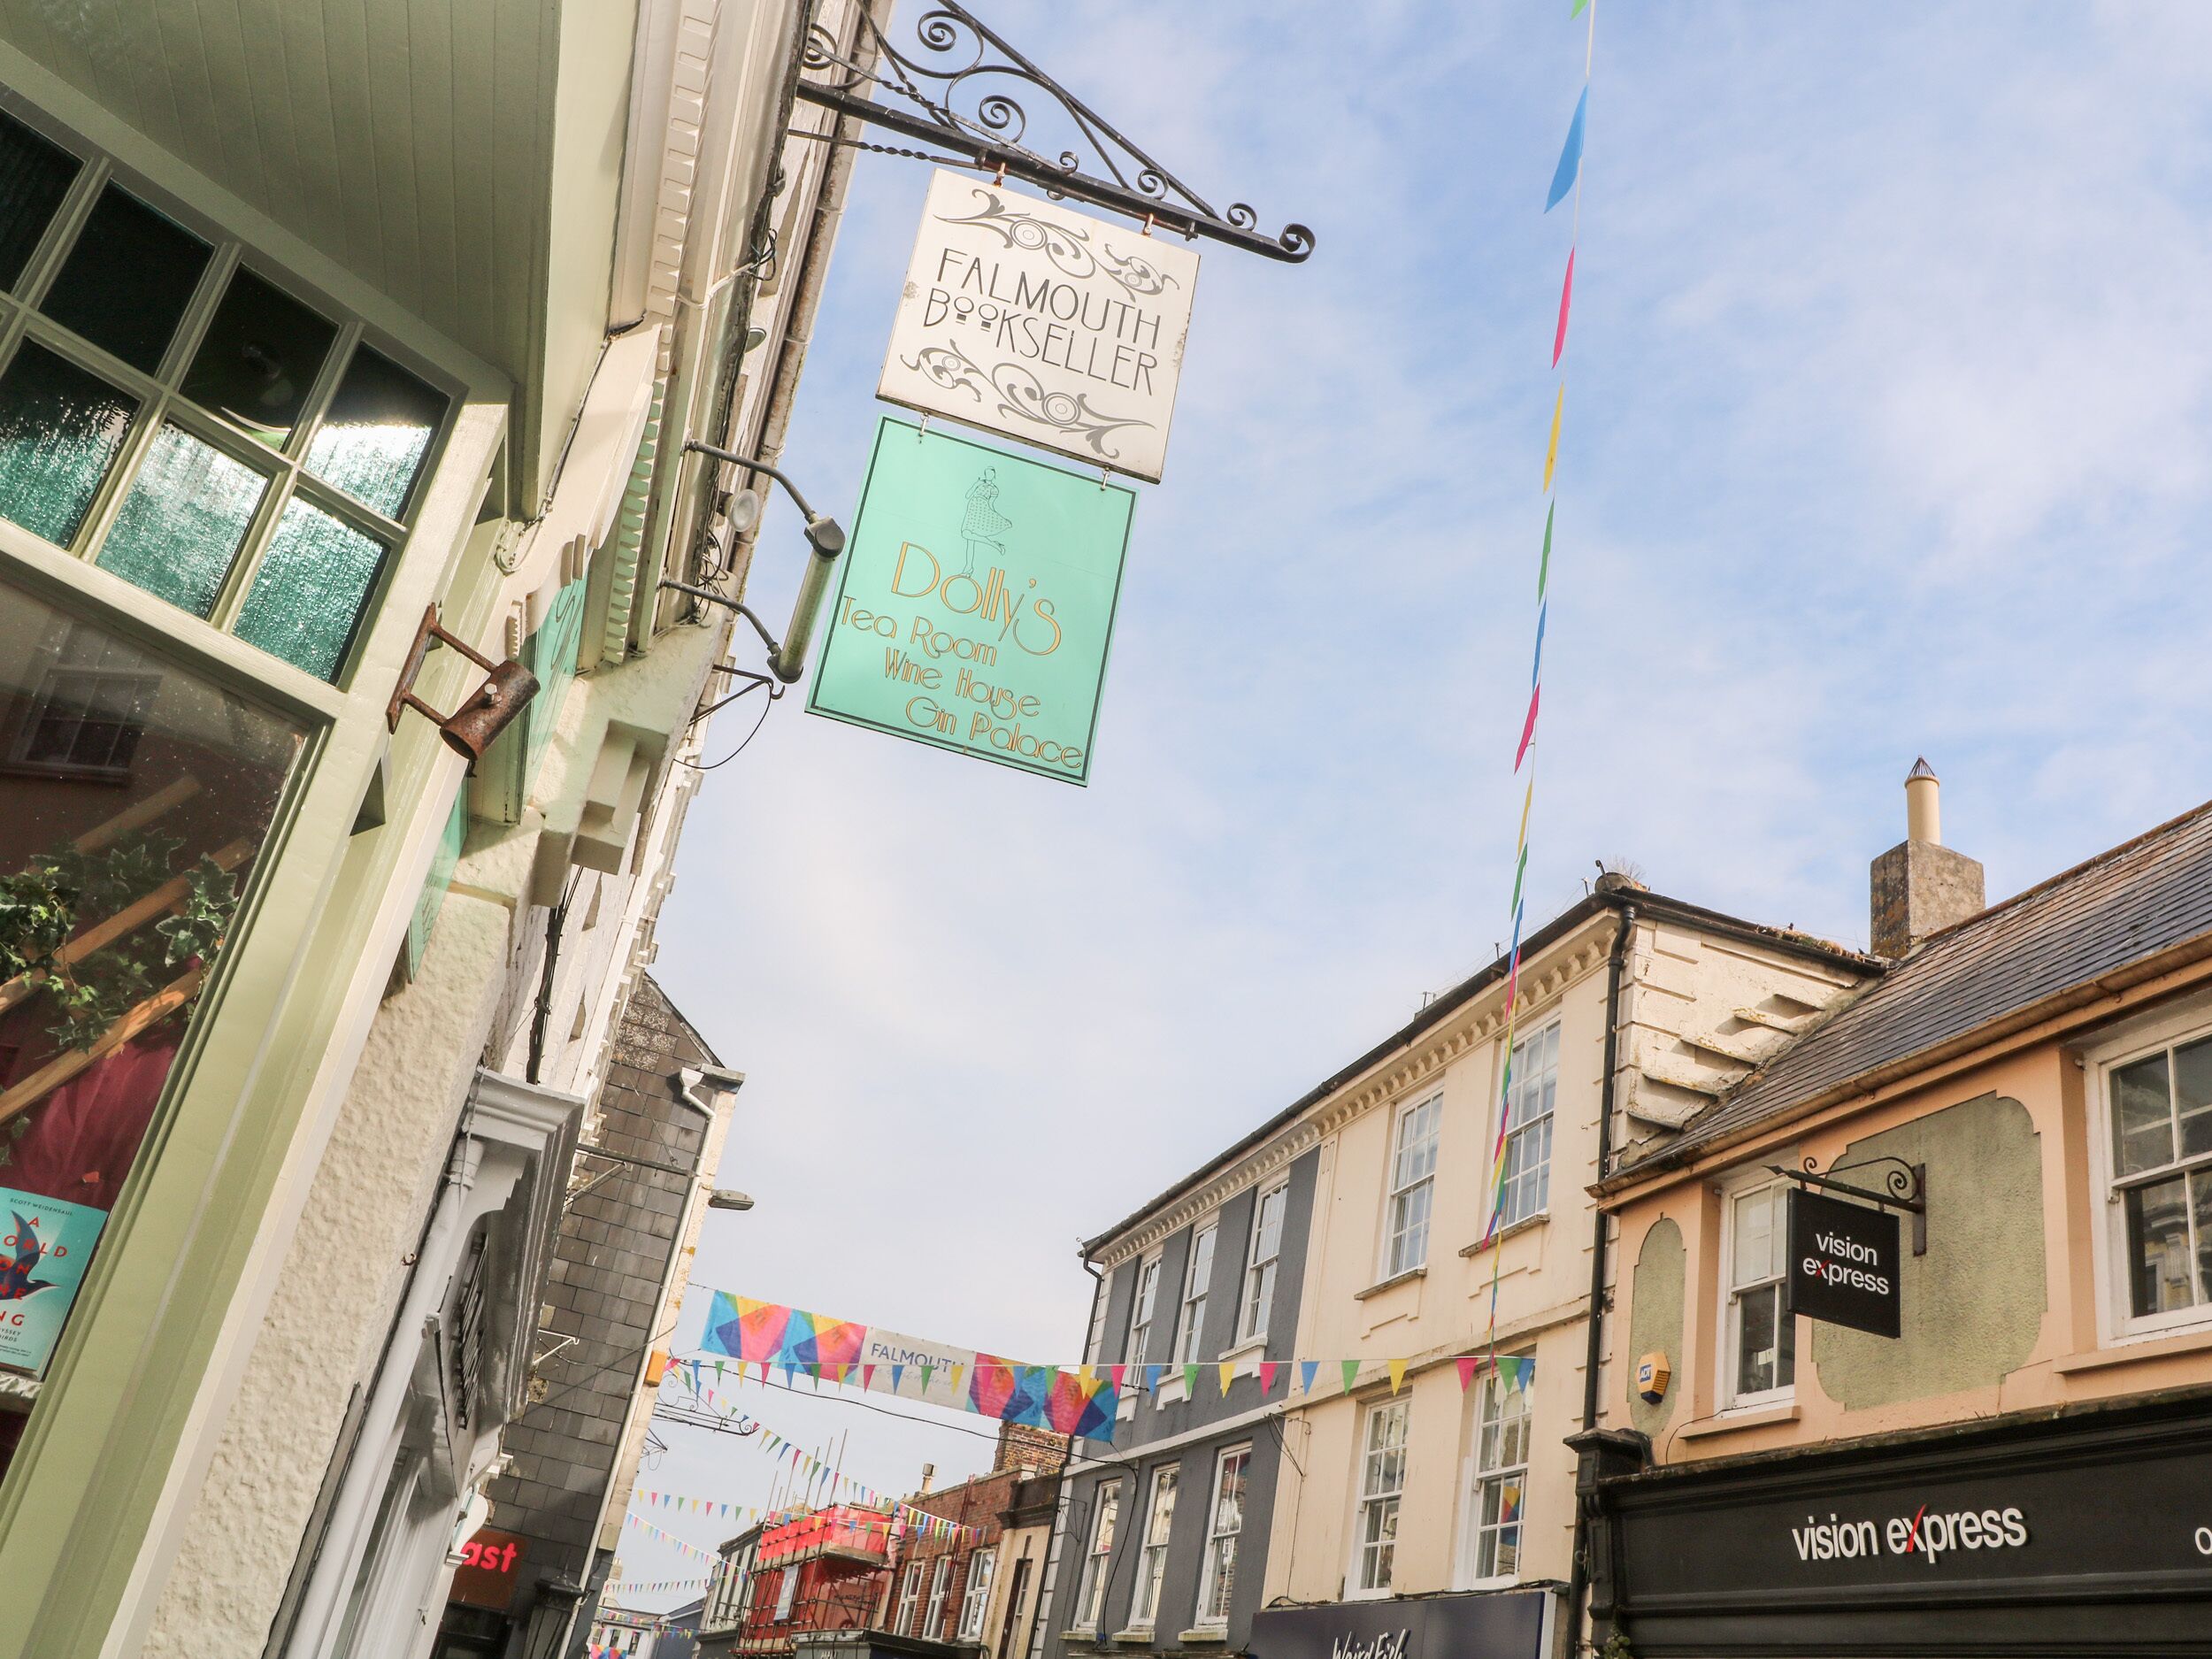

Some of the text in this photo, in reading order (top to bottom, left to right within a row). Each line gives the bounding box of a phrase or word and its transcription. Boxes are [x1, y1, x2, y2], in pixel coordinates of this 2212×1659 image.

[938, 249, 1162, 350] FALMOUTH
[923, 288, 1159, 396] BOOKSELLER
[891, 541, 1062, 657] Dolly's
[841, 595, 997, 667] Tea Room
[885, 646, 1041, 720] Wine House
[905, 695, 1083, 769] Gin Palace
[10, 1197, 31, 1207] SCOTT
[27, 1216, 40, 1228] A
[0, 1232, 68, 1257] ORLD
[1816, 1231, 1878, 1266] vision
[1802, 1257, 1889, 1295] express
[0, 1328, 21, 1337] YSSEY
[871, 1342, 964, 1373] FALMOUT
[1792, 1513, 1879, 1561] vision
[1886, 1504, 2028, 1564] express
